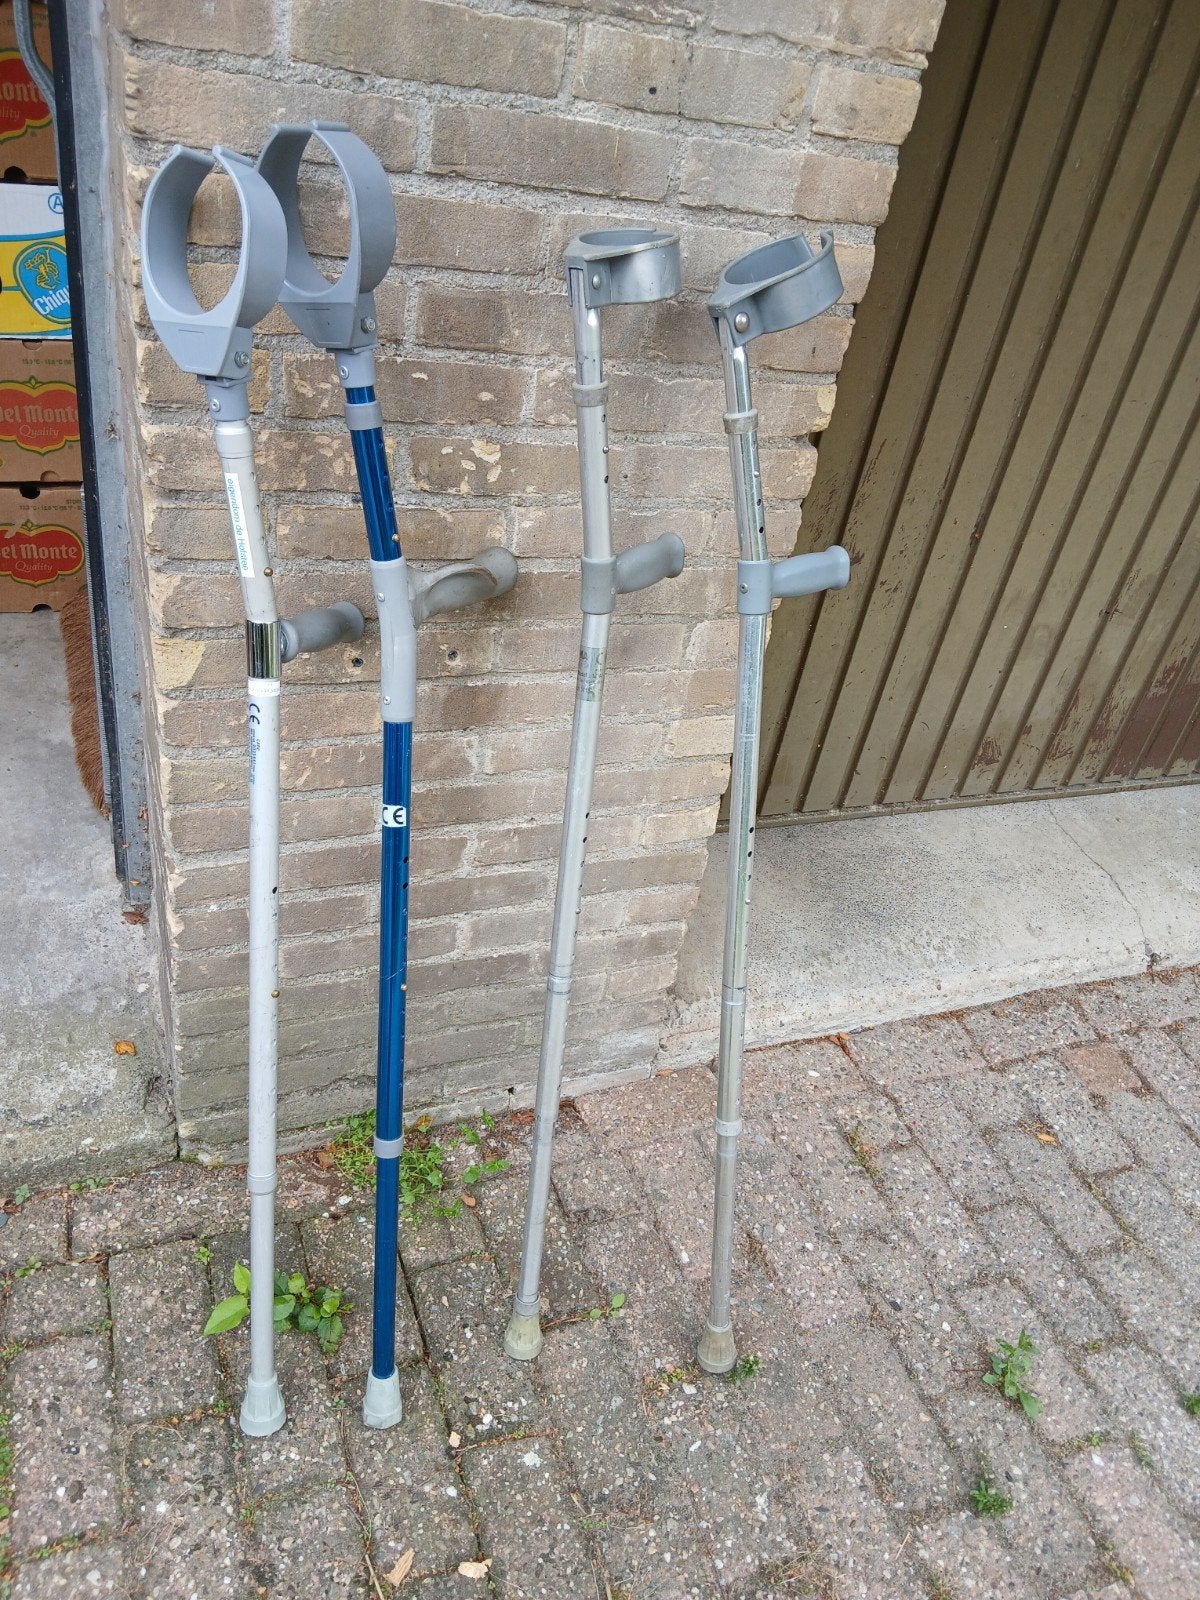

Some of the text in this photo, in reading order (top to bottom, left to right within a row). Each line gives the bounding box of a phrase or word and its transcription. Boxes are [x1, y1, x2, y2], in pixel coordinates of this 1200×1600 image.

[0, 81, 45, 103] ont
[20, 424, 59, 439] Quality
[0, 543, 78, 559] el Monte
[15, 561, 53, 573] Quality
[249, 703, 260, 725] CE
[382, 806, 404, 825] CE
